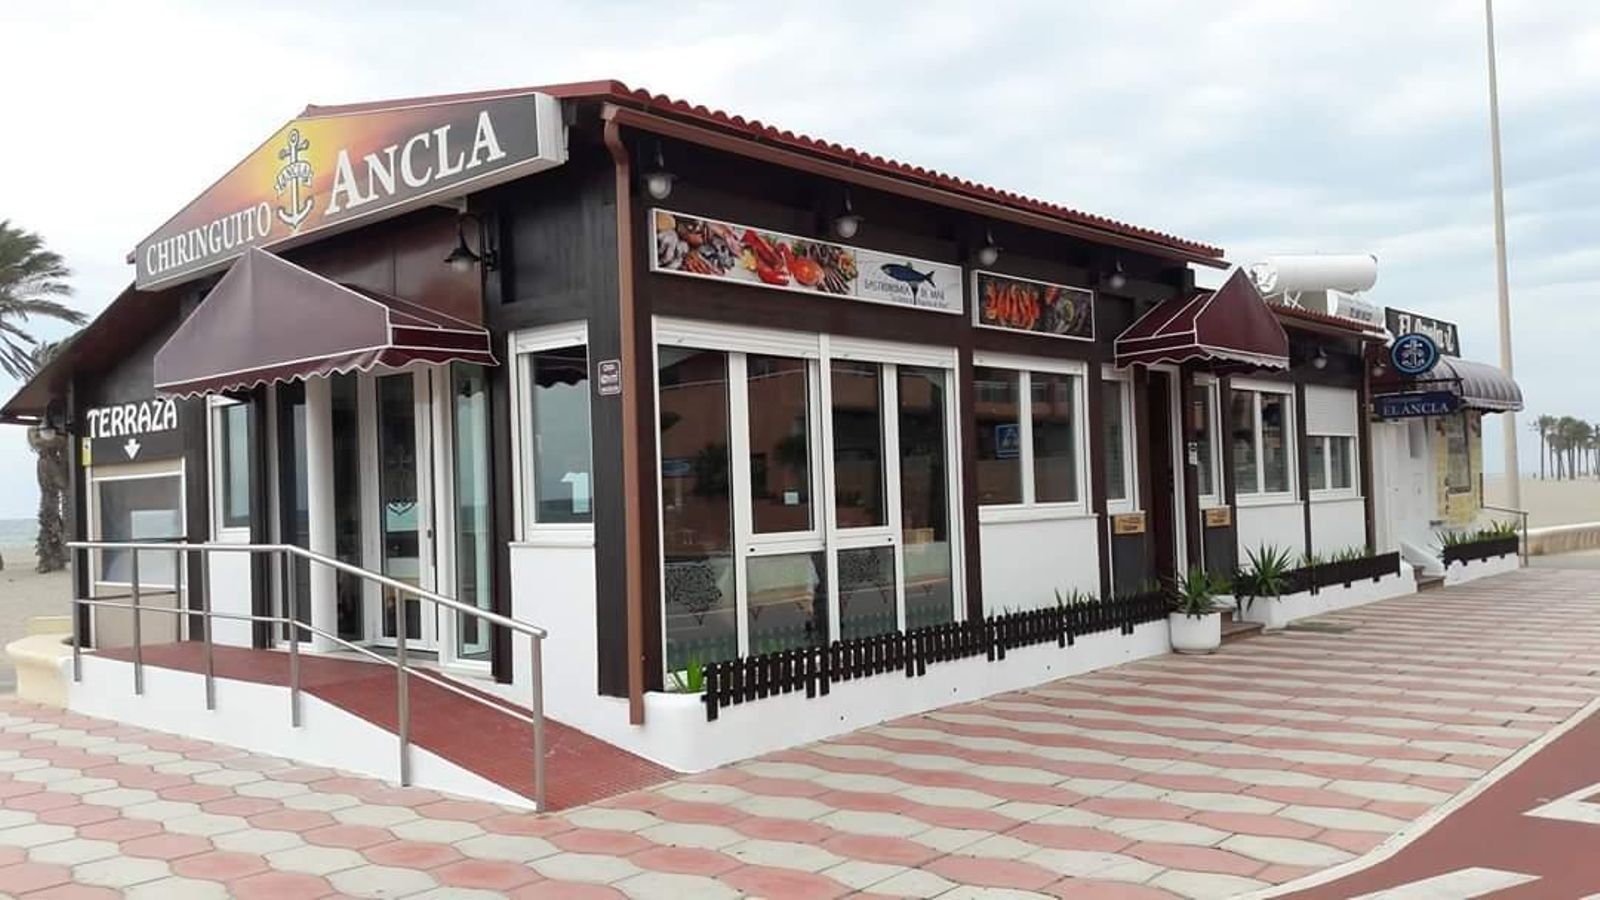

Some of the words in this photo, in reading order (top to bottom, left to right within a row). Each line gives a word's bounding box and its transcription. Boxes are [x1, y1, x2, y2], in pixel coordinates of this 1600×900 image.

[146, 201, 272, 276] CHIRINGUITO
[324, 110, 507, 216] ANCLA
[86, 399, 178, 439] TERRAZA
[1383, 405, 1400, 416] EL
[1401, 402, 1449, 415] ANCLA
